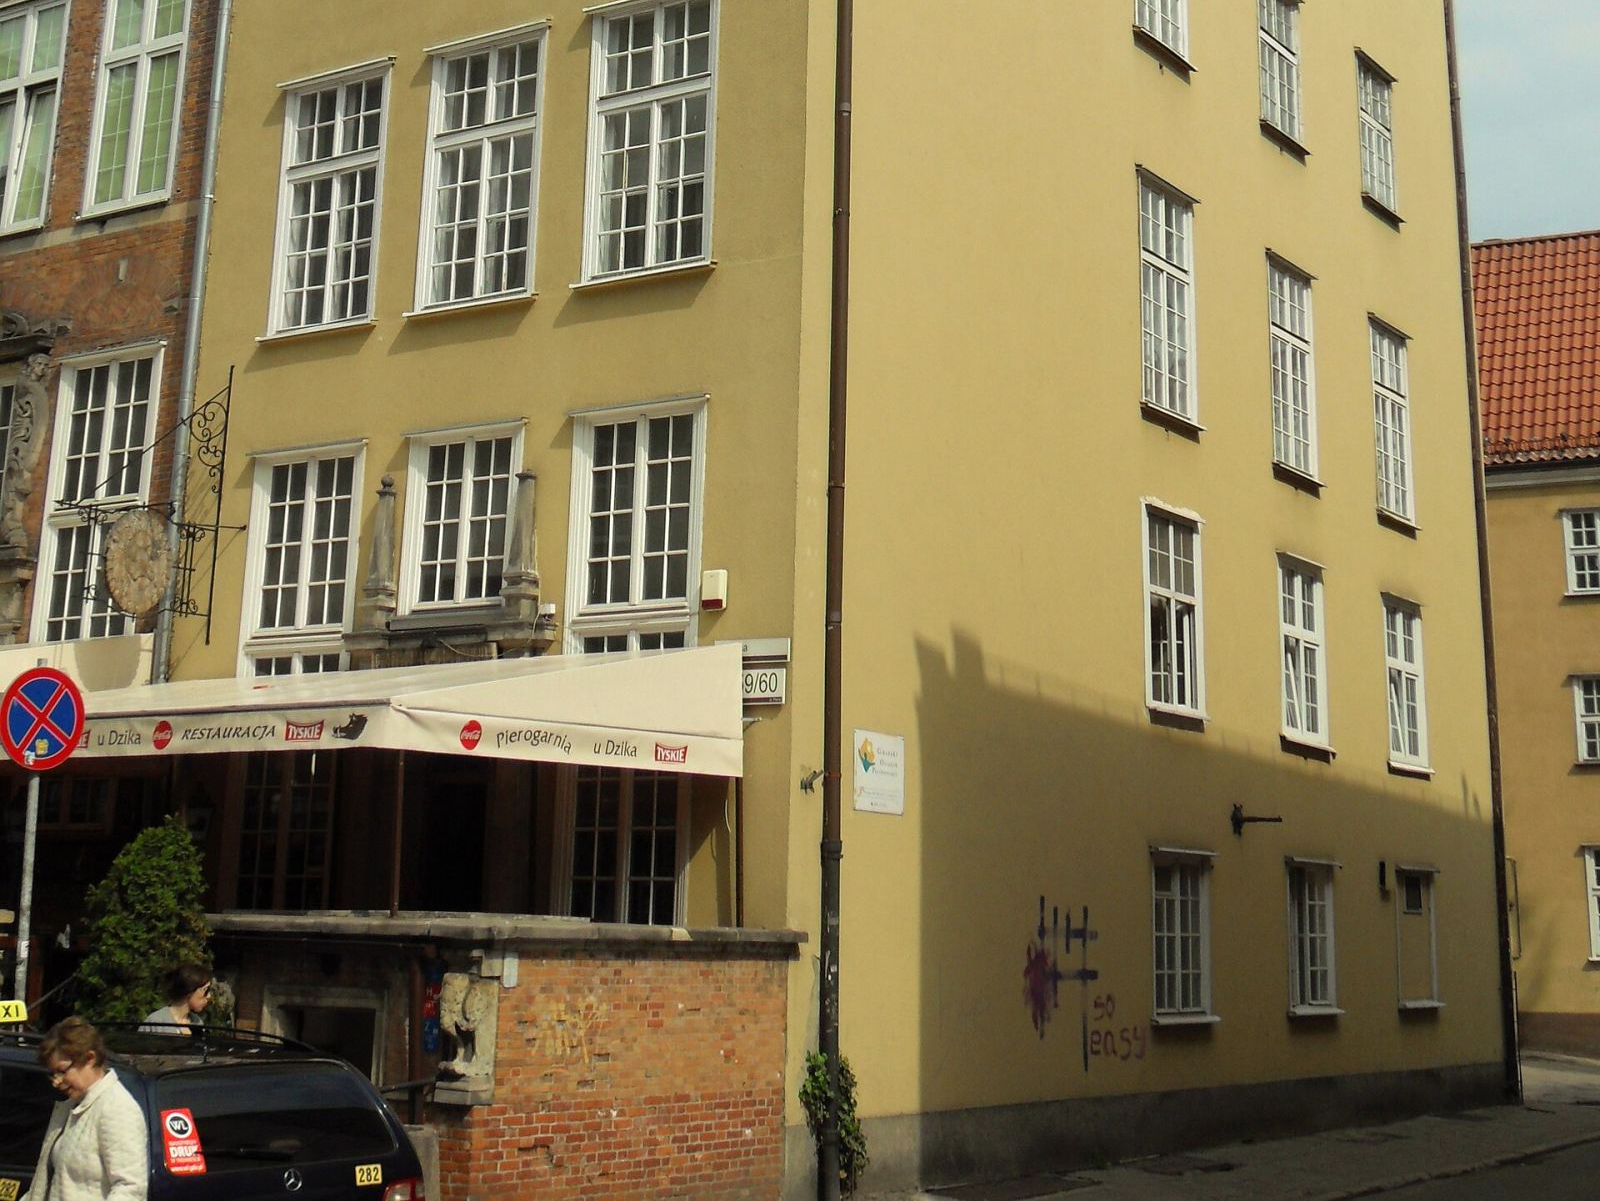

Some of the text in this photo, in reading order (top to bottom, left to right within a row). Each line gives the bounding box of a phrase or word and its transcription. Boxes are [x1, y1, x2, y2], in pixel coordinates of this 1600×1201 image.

[742, 672, 778, 694] 9/60
[97, 734, 105, 746] u
[108, 730, 141, 745] Dzika
[181, 725, 277, 741] RESTAURACJA
[287, 724, 321, 740] TYSKIE
[496, 729, 572, 755] Pierogarnia
[594, 740, 637, 757] u Dzika
[656, 746, 685, 762] TYSKIE
[358, 1166, 380, 1183] 282
